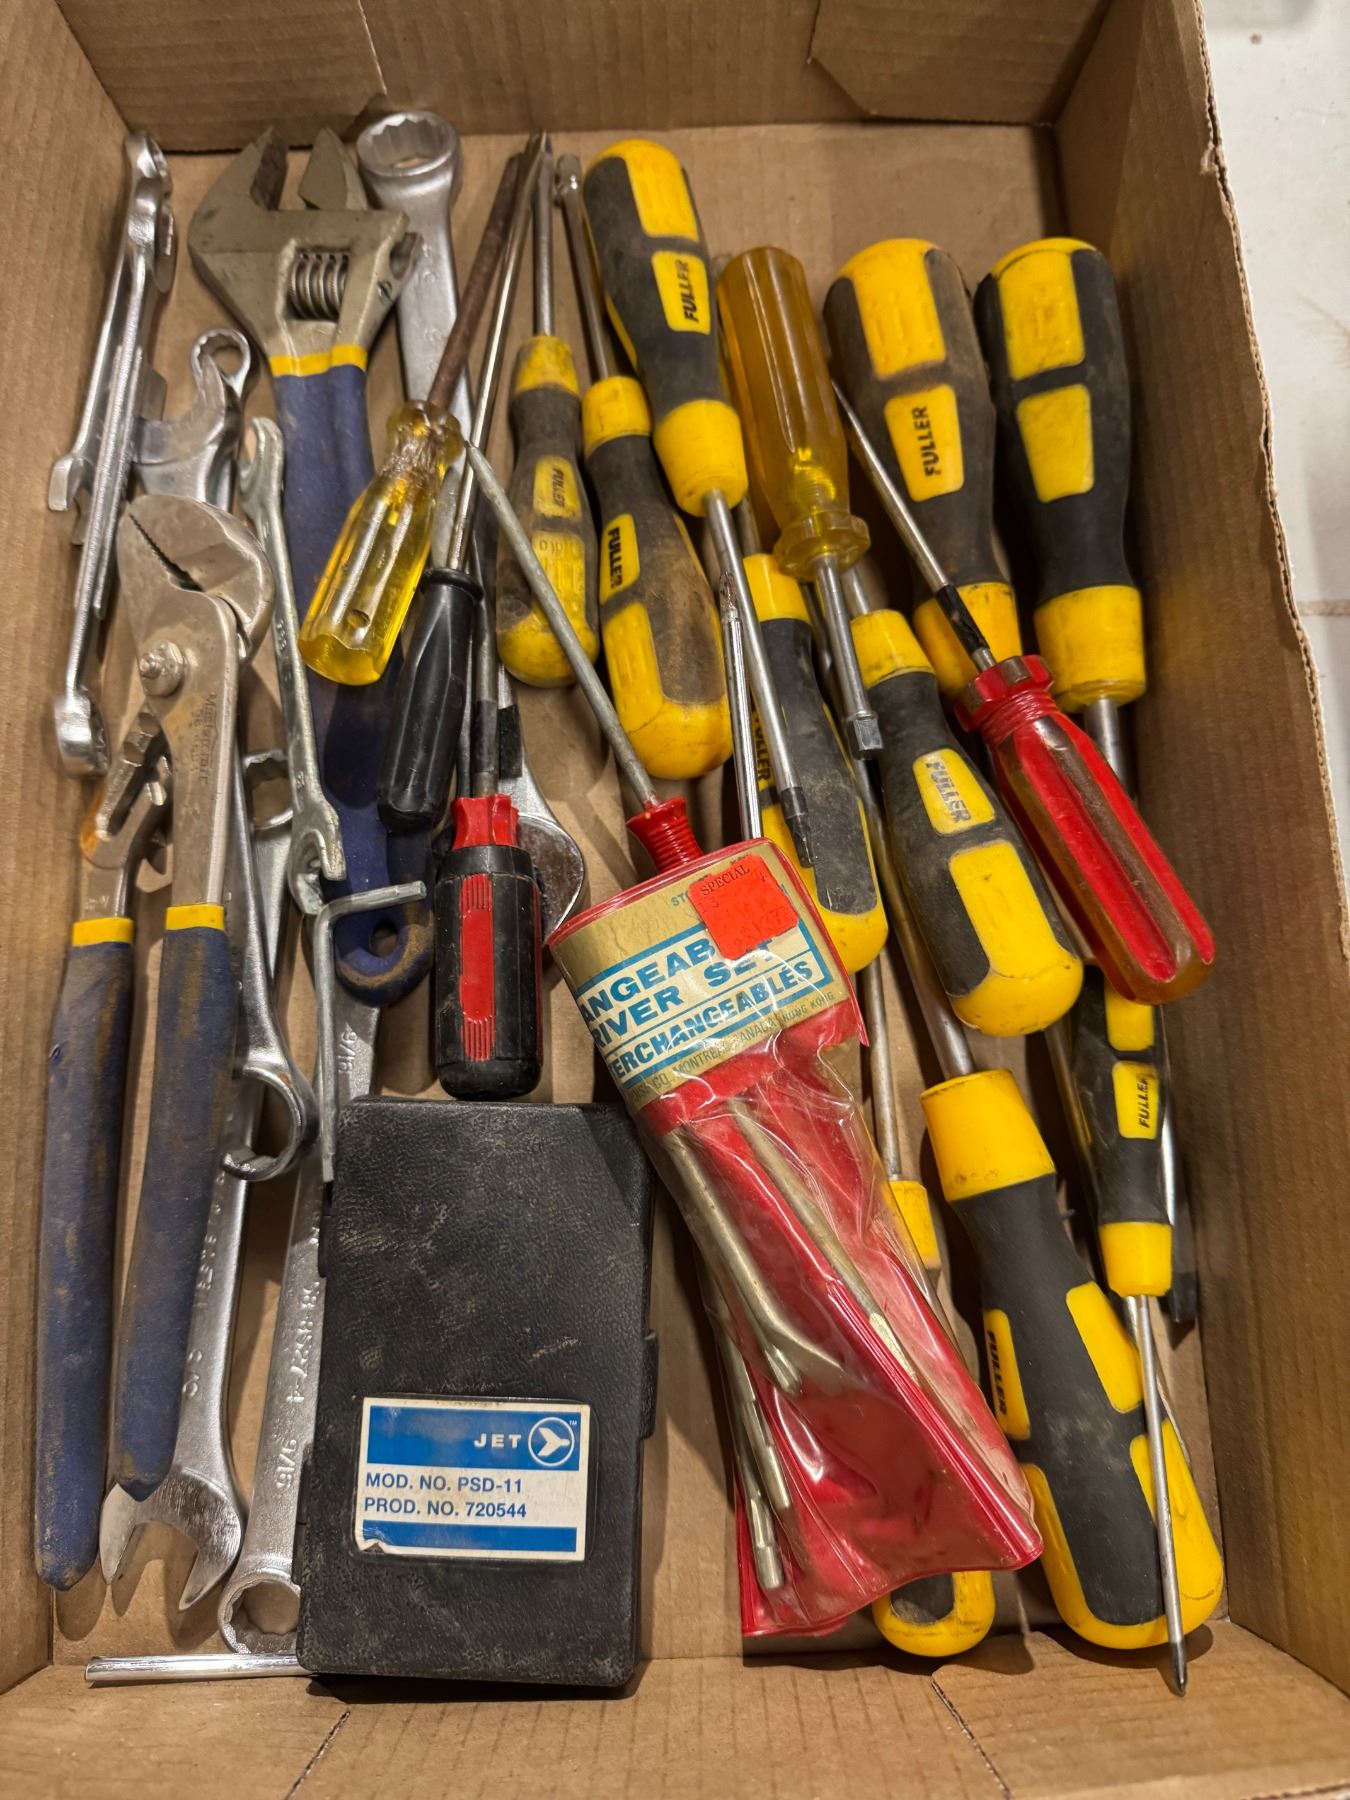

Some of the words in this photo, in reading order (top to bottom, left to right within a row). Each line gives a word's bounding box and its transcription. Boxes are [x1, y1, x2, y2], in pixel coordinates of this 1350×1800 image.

[674, 259, 699, 323] FULLER
[911, 405, 942, 477] FULLER
[754, 717, 771, 780] ULLER
[925, 760, 972, 823] FULLER
[700, 864, 750, 896] SPECIAL
[580, 938, 715, 1022] ANGEAB
[736, 1017, 777, 1045] ANADA
[987, 1330, 1007, 1416] FULLER
[473, 1433, 522, 1449] JET
[364, 1497, 421, 1515] PROD.
[427, 1500, 459, 1517] NO.
[465, 1501, 527, 1518] 720544
[365, 1472, 413, 1490] MOD.
[419, 1475, 451, 1492] NO.
[457, 1477, 522, 1494] PSD-11
